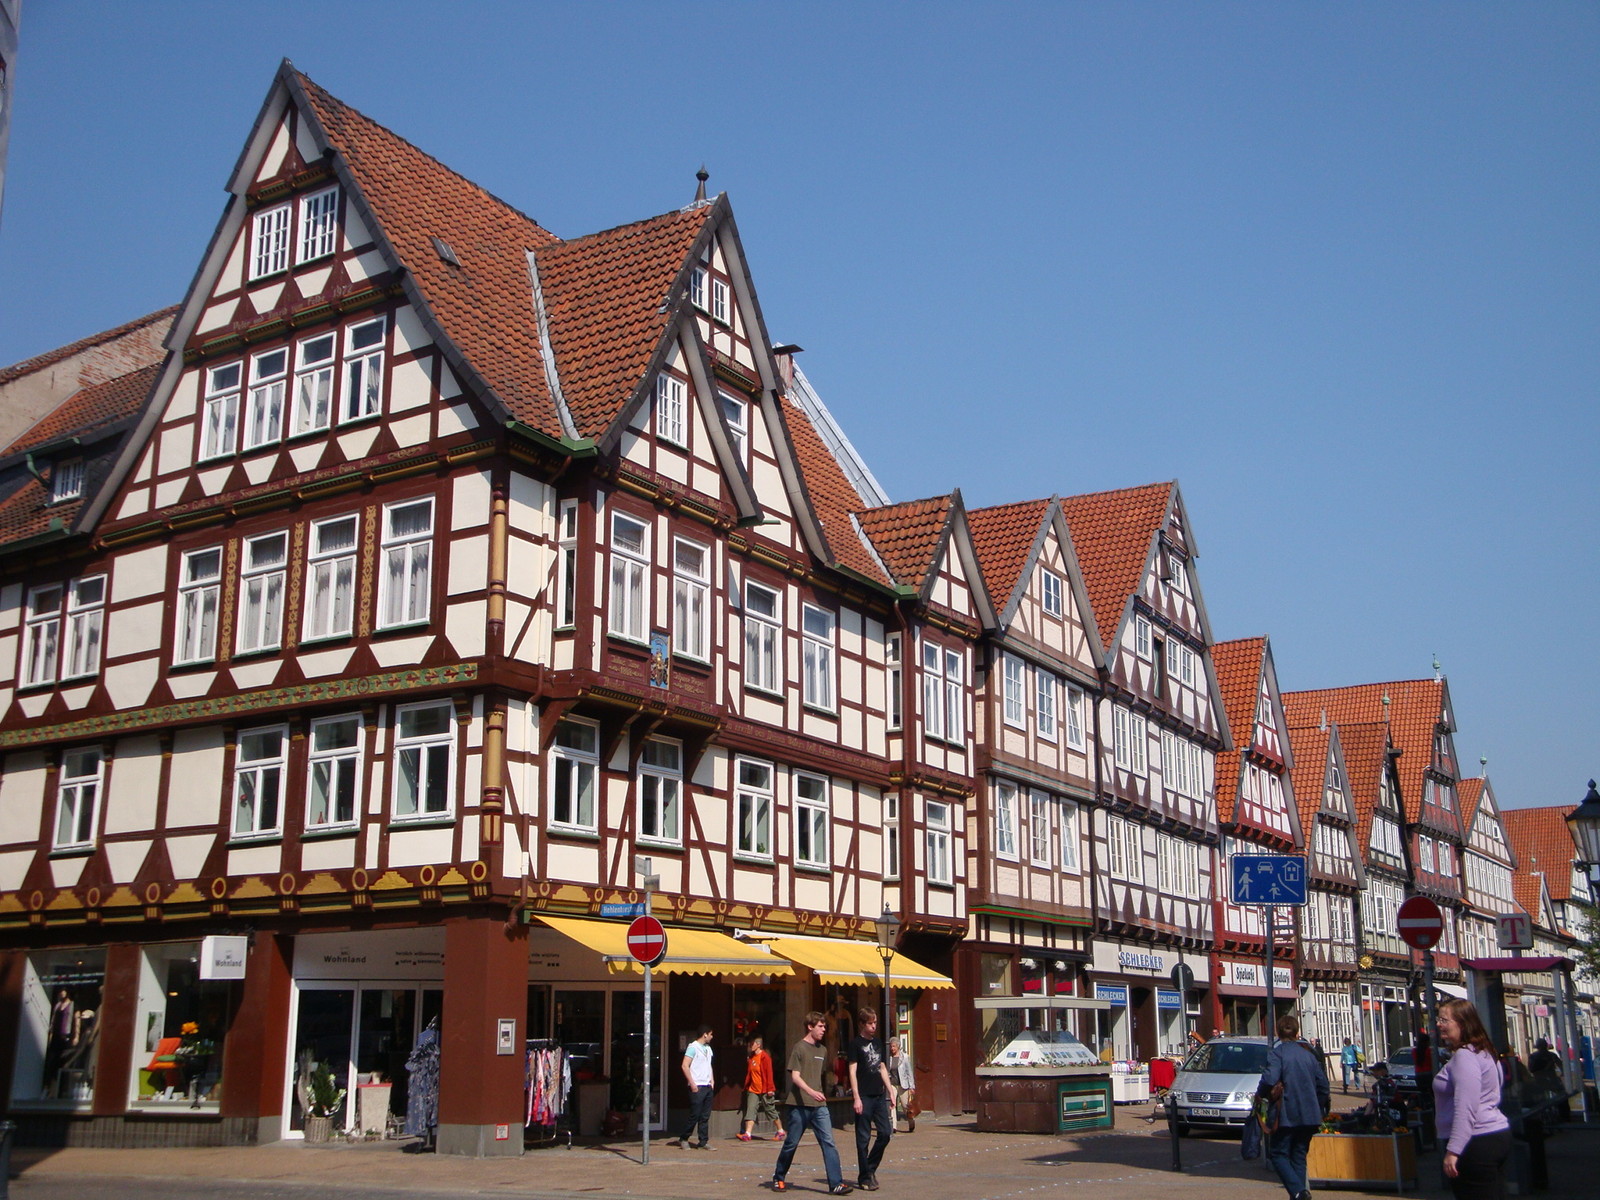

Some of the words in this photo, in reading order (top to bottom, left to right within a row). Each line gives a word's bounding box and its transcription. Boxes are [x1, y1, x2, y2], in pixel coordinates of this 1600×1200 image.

[636, 468, 652, 480] unser
[1501, 917, 1525, 945] T
[215, 959, 242, 967] Wohnland
[324, 955, 366, 963] Wohnland
[1119, 951, 1164, 969] SCHLECKER
[1097, 990, 1125, 1001] SCHLECKER
[1158, 995, 1180, 1003] SCHLECKER
